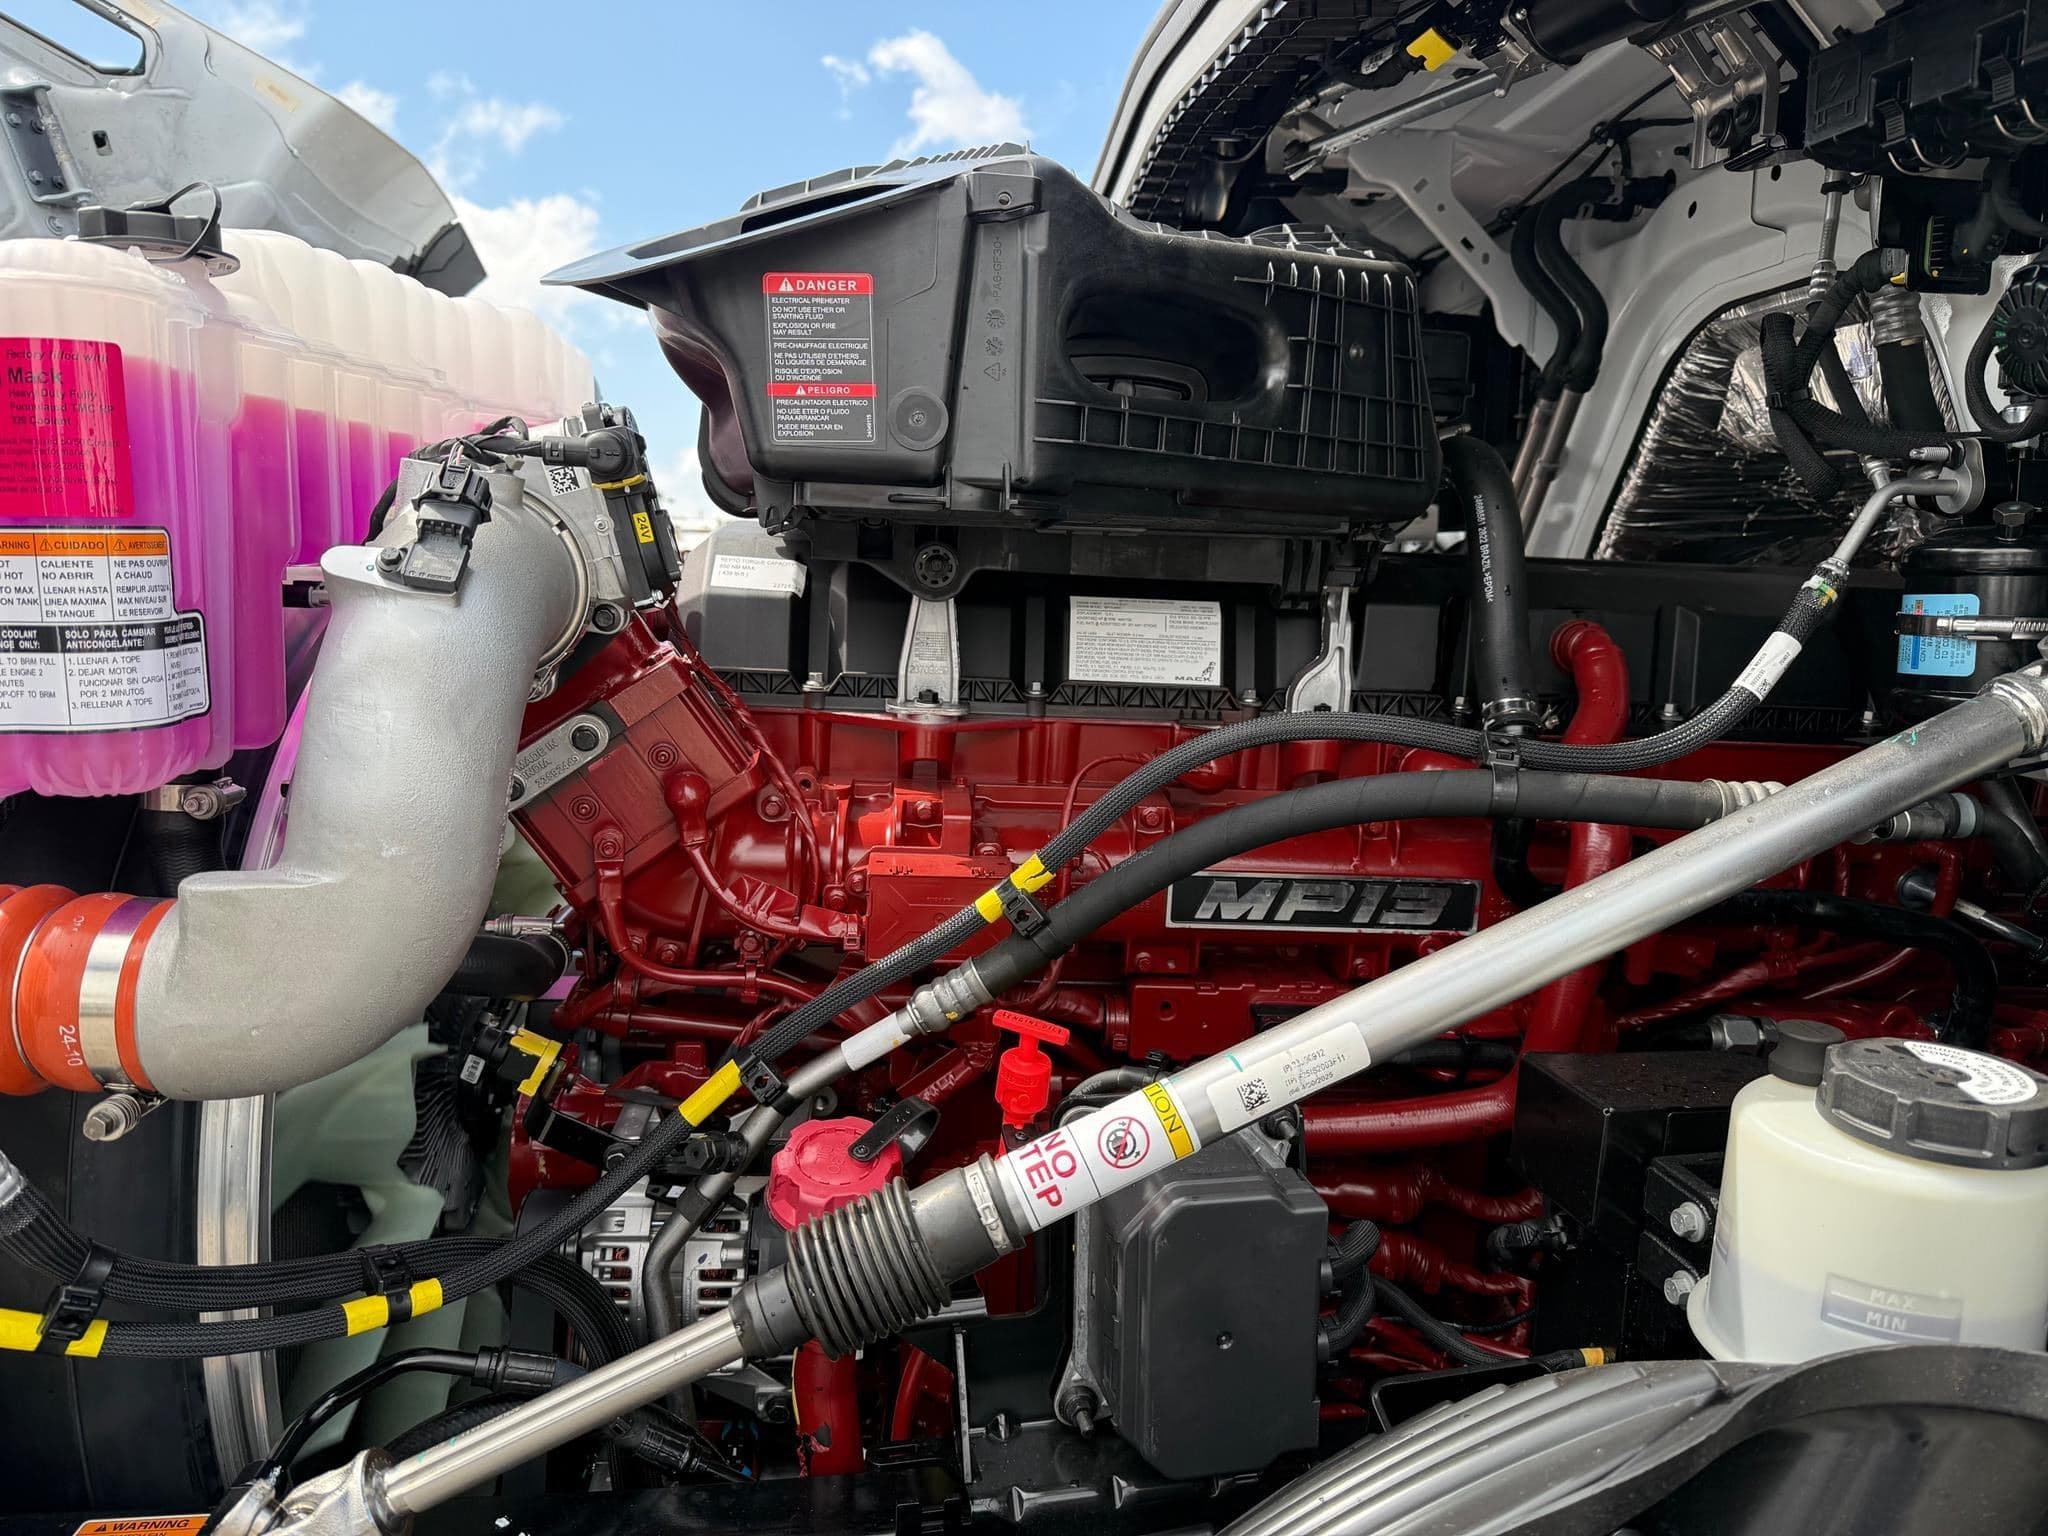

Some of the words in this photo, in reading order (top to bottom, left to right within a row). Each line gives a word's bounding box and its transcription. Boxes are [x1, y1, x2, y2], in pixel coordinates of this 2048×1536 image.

[796, 280, 858, 291] DANGER
[7, 368, 62, 384] Mack
[636, 516, 650, 539] 24V
[54, 541, 104, 549] CUIDADO
[1480, 544, 1491, 572] BRAZIL
[41, 560, 94, 568] CALIENTE
[114, 560, 126, 568] NE
[129, 560, 144, 568] PAS
[4, 572, 23, 580] HOT
[42, 572, 56, 580] NO
[60, 572, 94, 580] ABRIR
[124, 571, 152, 579] CHAUD
[15, 586, 34, 594] MAX
[79, 586, 109, 594] HASTA
[44, 598, 68, 606] LINEA
[118, 597, 133, 605] MAX
[46, 610, 56, 618] EN
[1, 630, 37, 639] COOLANT
[65, 630, 89, 639] SOLO
[94, 629, 117, 638] PARA
[122, 628, 156, 637] CAMBIAR
[19, 640, 40, 649] ONLY:
[66, 639, 144, 649] ANTICONGELANTE:
[77, 657, 109, 665] LLENAR
[121, 655, 141, 664] TOPE
[78, 668, 105, 676] DEJAR
[109, 666, 137, 675] MOTOR
[79, 679, 123, 687] FUNCIONAR
[127, 677, 138, 685] SIN
[142, 675, 163, 684] CARGA
[80, 690, 98, 698] POR
[111, 688, 144, 697] MINUTOS
[80, 700, 123, 709] RELLENAR
[134, 697, 153, 706] TOPE
[516, 748, 547, 772] MADE
[59, 1024, 83, 1066] 24-10
[1040, 1131, 1077, 1179] NO
[1020, 1142, 1063, 1208] TEP
[1870, 1288, 1915, 1310] MAX
[1866, 1311, 1907, 1330] MIN
[113, 1520, 190, 1531] WARNING
